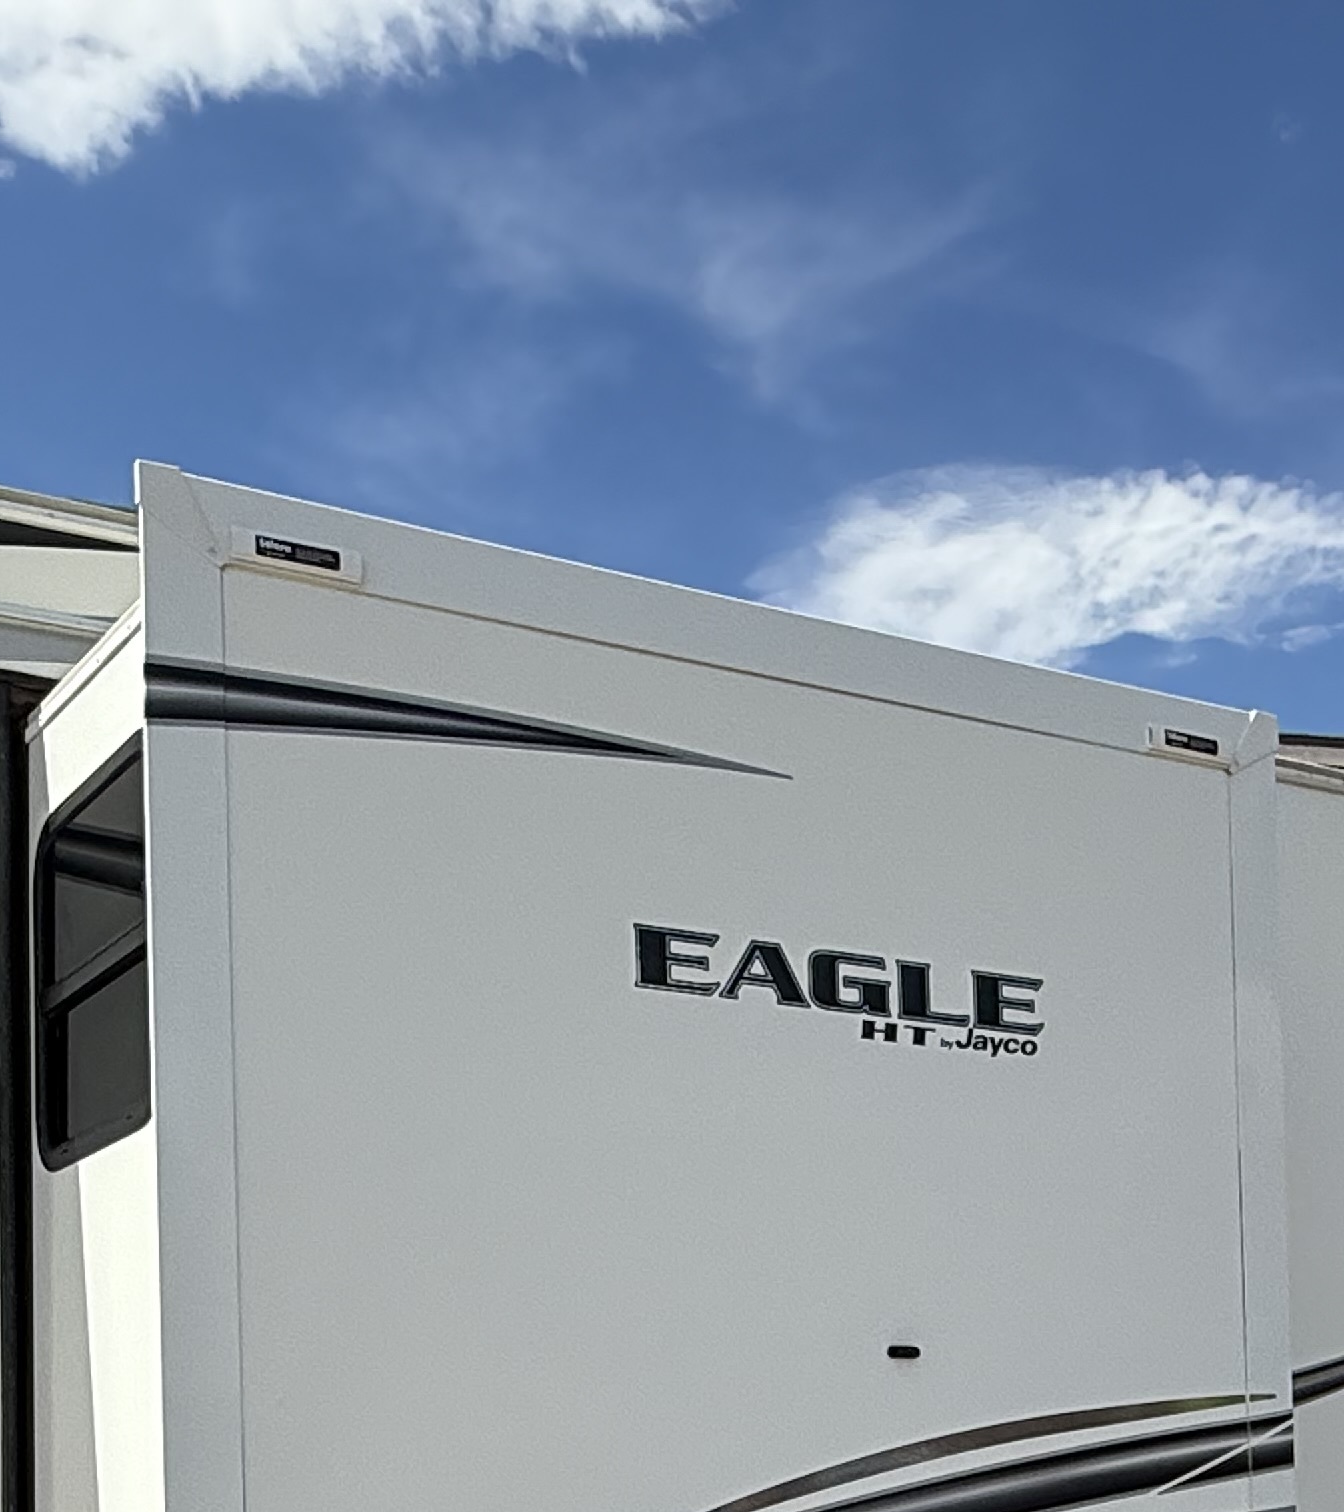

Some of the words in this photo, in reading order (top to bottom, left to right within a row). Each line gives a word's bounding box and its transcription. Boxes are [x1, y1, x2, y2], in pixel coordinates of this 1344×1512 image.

[633, 922, 1046, 1036] EAGLE
[861, 1019, 936, 1046] HT
[940, 1037, 955, 1050] by
[955, 1028, 1039, 1058] Jayco
